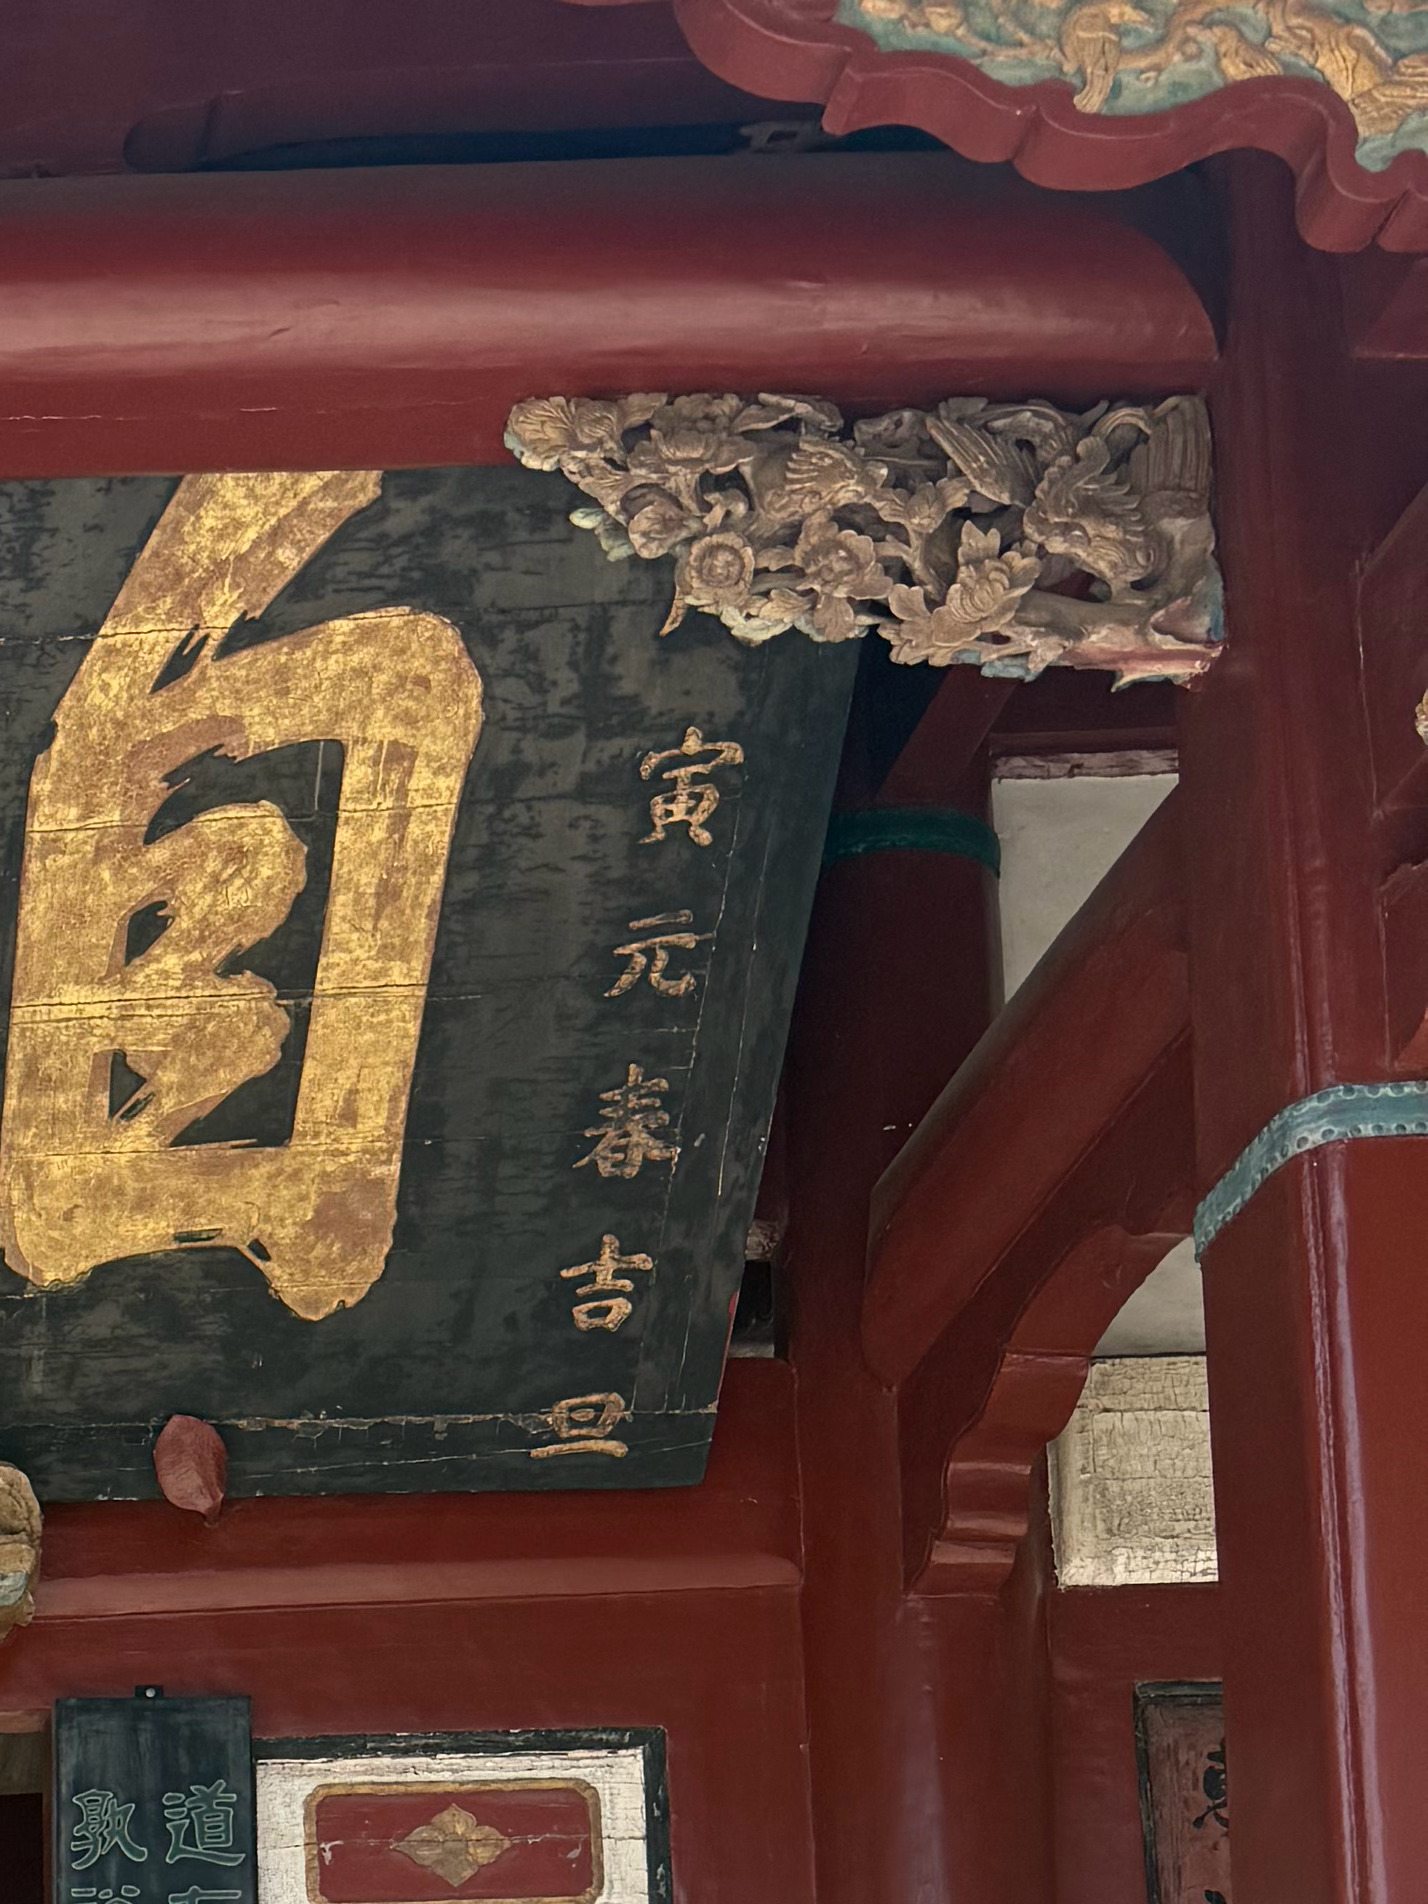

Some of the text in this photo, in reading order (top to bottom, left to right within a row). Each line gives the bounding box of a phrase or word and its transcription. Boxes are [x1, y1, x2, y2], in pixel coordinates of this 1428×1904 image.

[529, 726, 744, 1459] 寅元春吉旦
